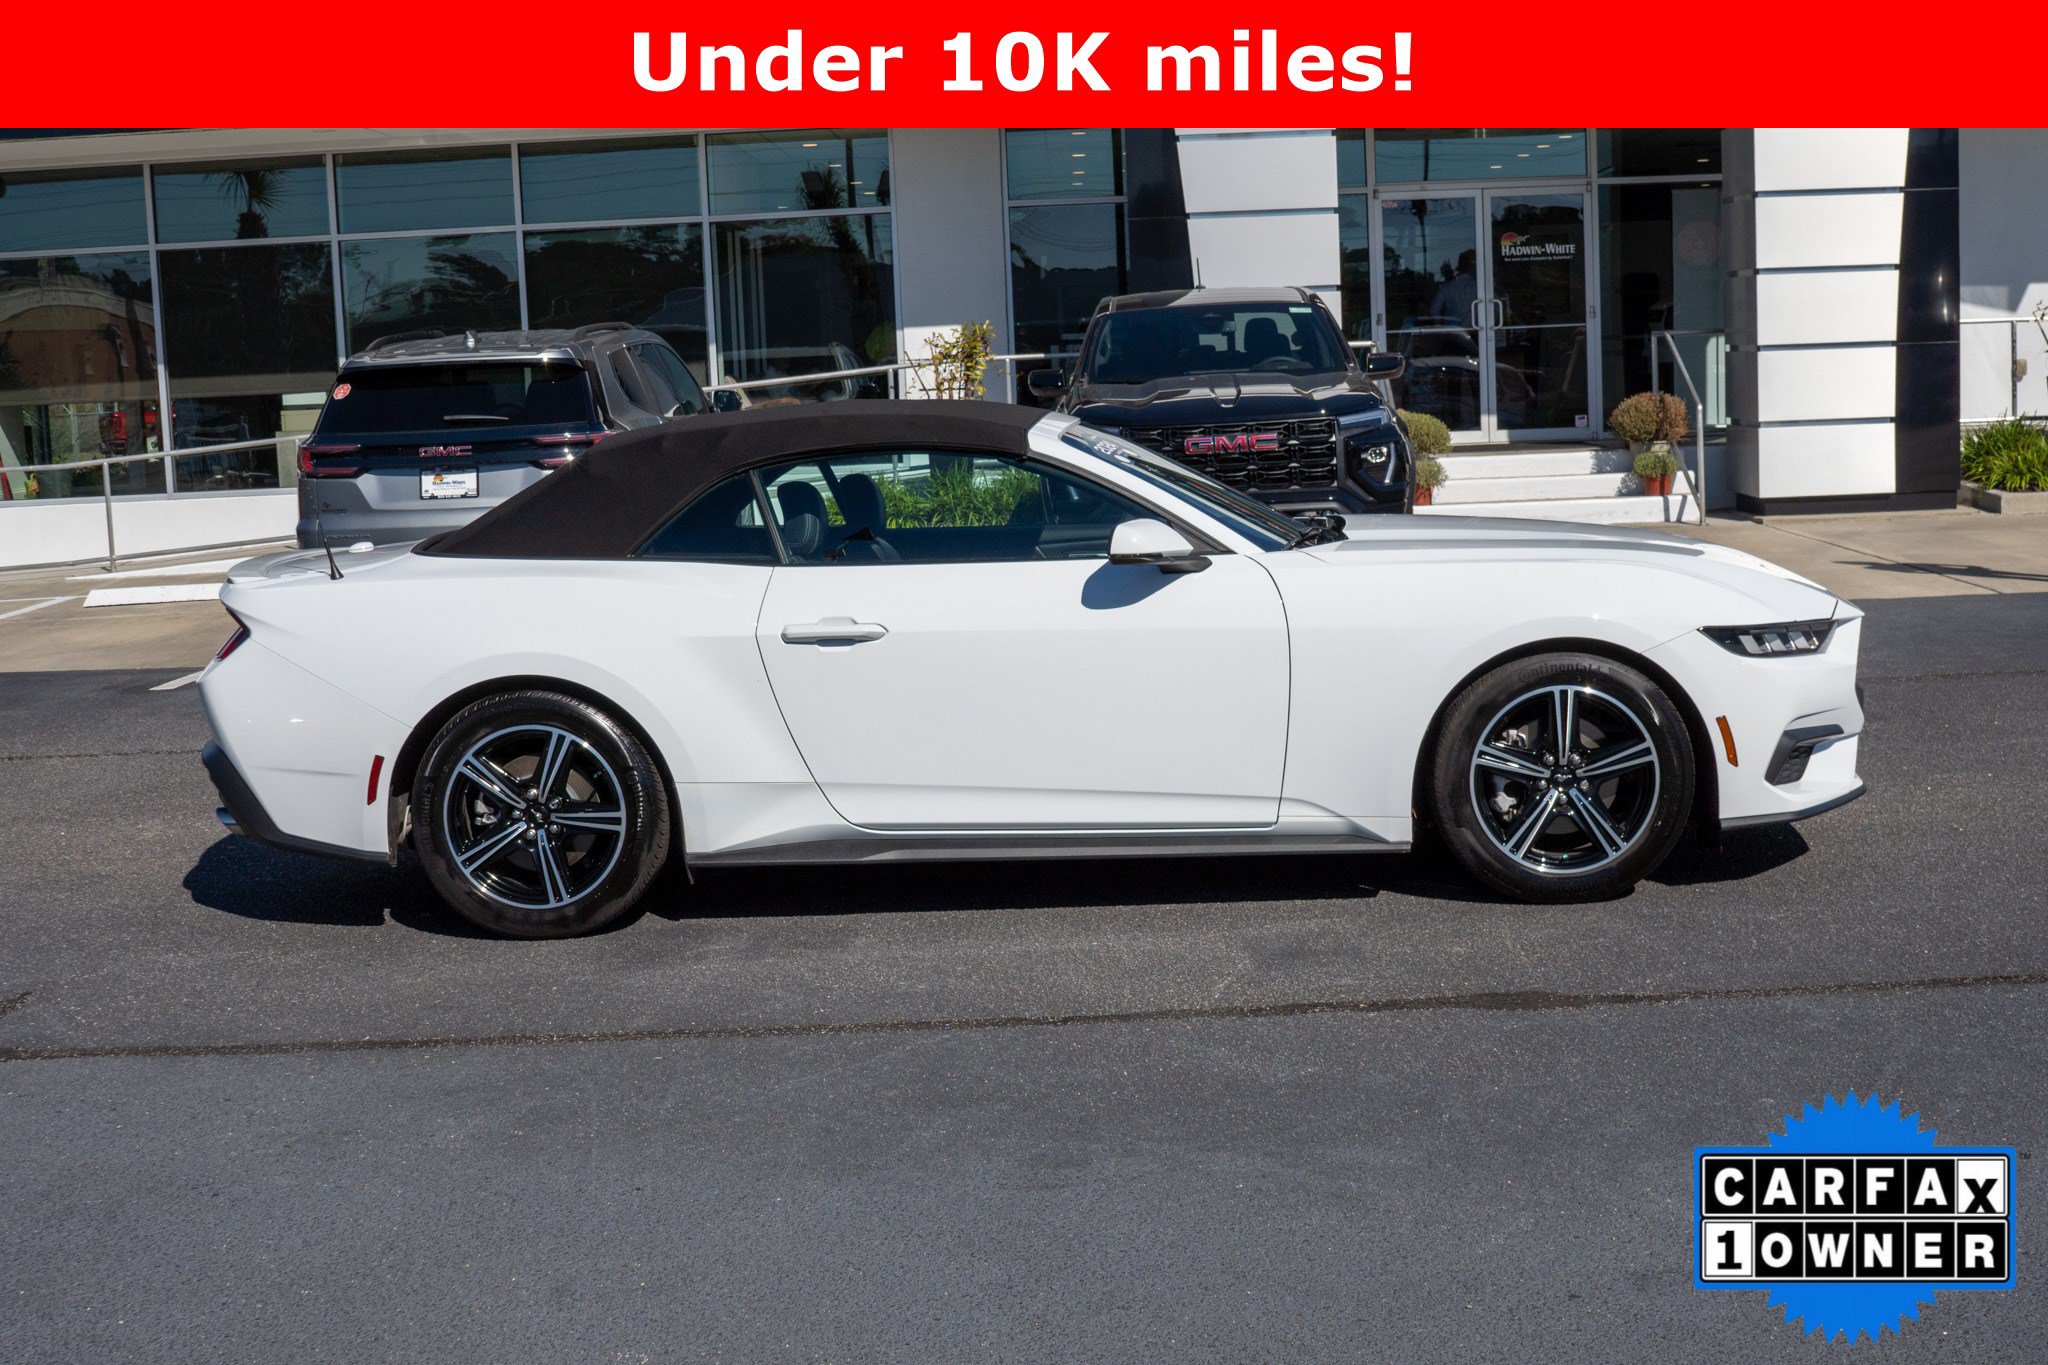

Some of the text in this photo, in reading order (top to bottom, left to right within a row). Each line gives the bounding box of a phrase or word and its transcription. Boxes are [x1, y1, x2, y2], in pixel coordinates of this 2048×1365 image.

[1501, 243, 1576, 256] HADWIN-WHITE
[419, 445, 473, 457] GMC
[1184, 434, 1279, 454] GMC
[1518, 662, 1593, 683] Continental
